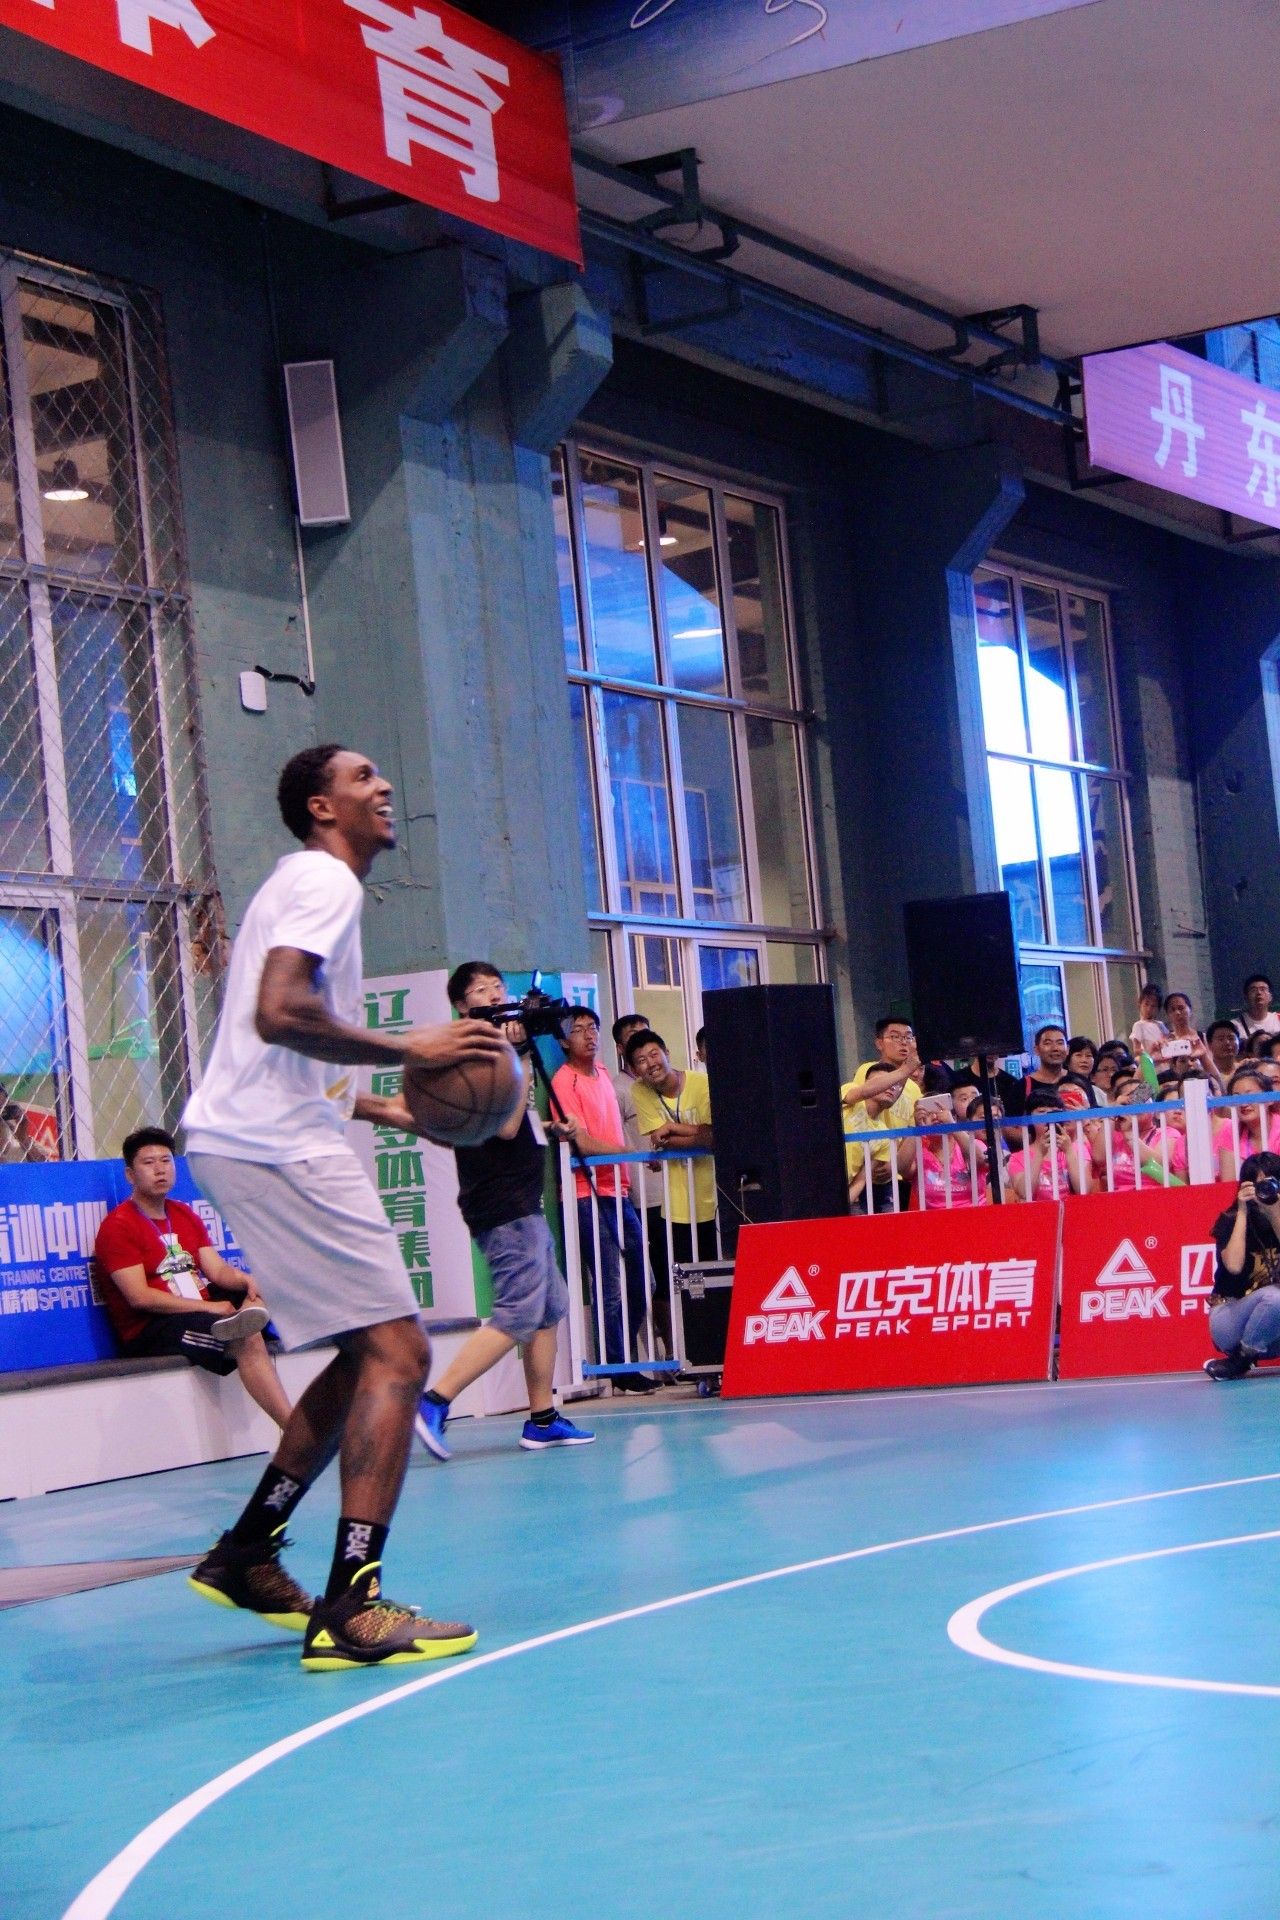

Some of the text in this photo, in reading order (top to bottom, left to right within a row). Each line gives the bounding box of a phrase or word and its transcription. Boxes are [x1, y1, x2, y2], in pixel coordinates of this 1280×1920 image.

[1, 1265, 87, 1286] TRAINING CENTRE
[836, 1258, 1037, 1320] 匹克体育
[0, 1288, 38, 1315] 精神
[1079, 1285, 1174, 1323] PEAK
[743, 1310, 831, 1346] PEAK
[835, 1312, 1032, 1339] PEAK SPORT
